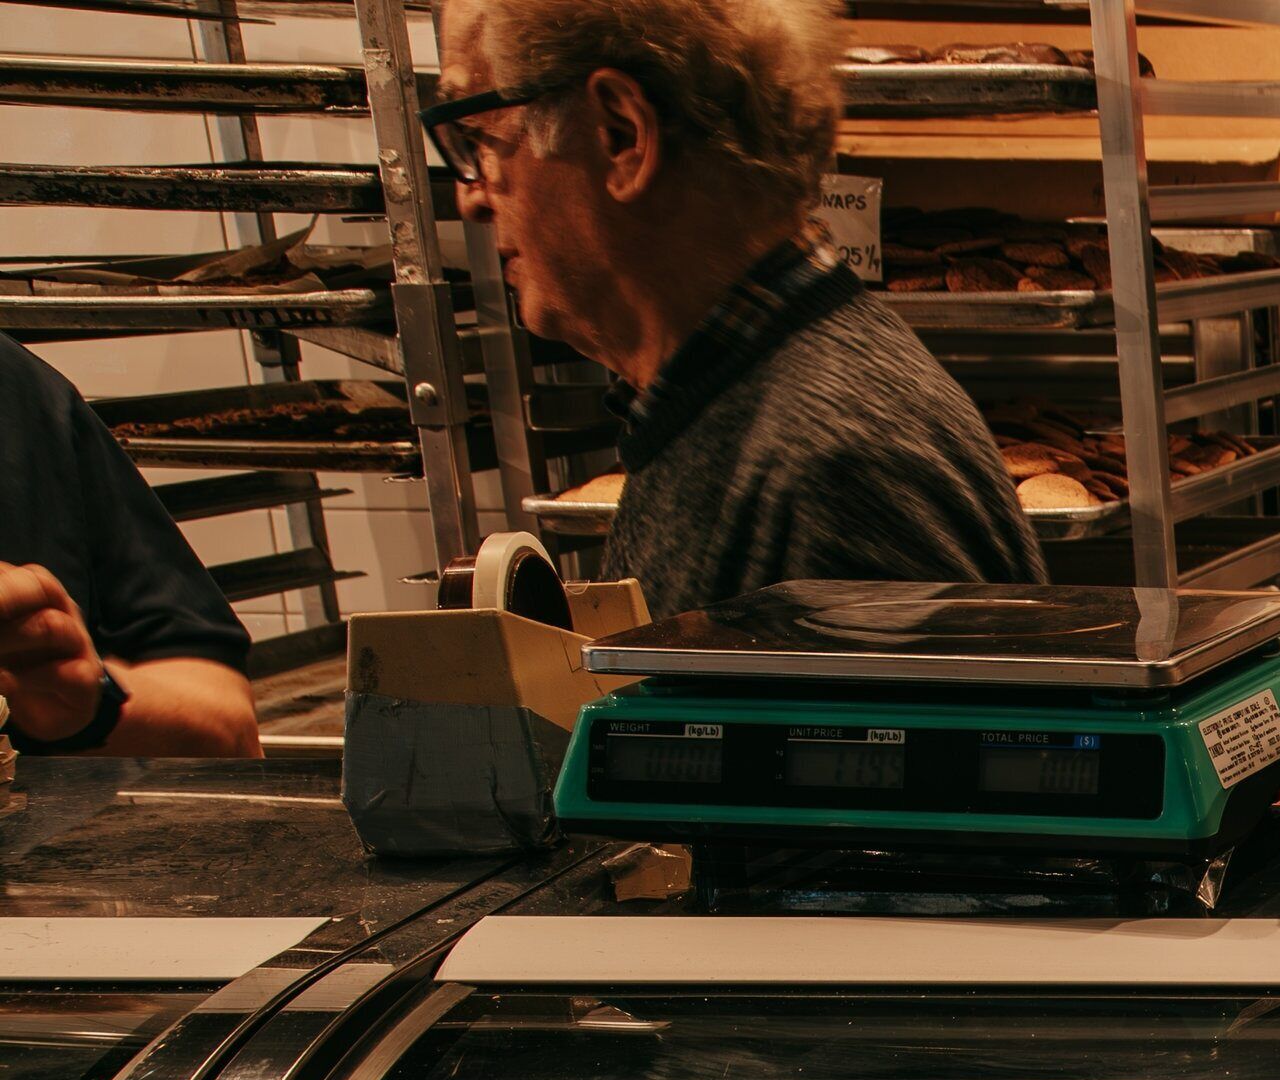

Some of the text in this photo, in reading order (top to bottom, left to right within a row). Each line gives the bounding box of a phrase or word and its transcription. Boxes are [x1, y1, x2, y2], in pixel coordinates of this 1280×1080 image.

[821, 193, 868, 211] NAPS
[609, 722, 720, 737] WEIGHT (kg/Lb)
[788, 728, 903, 743] UNIT PRICE (kg/Lb)
[980, 732, 1014, 744] TOTAL
[1018, 733, 1050, 745] PRICE
